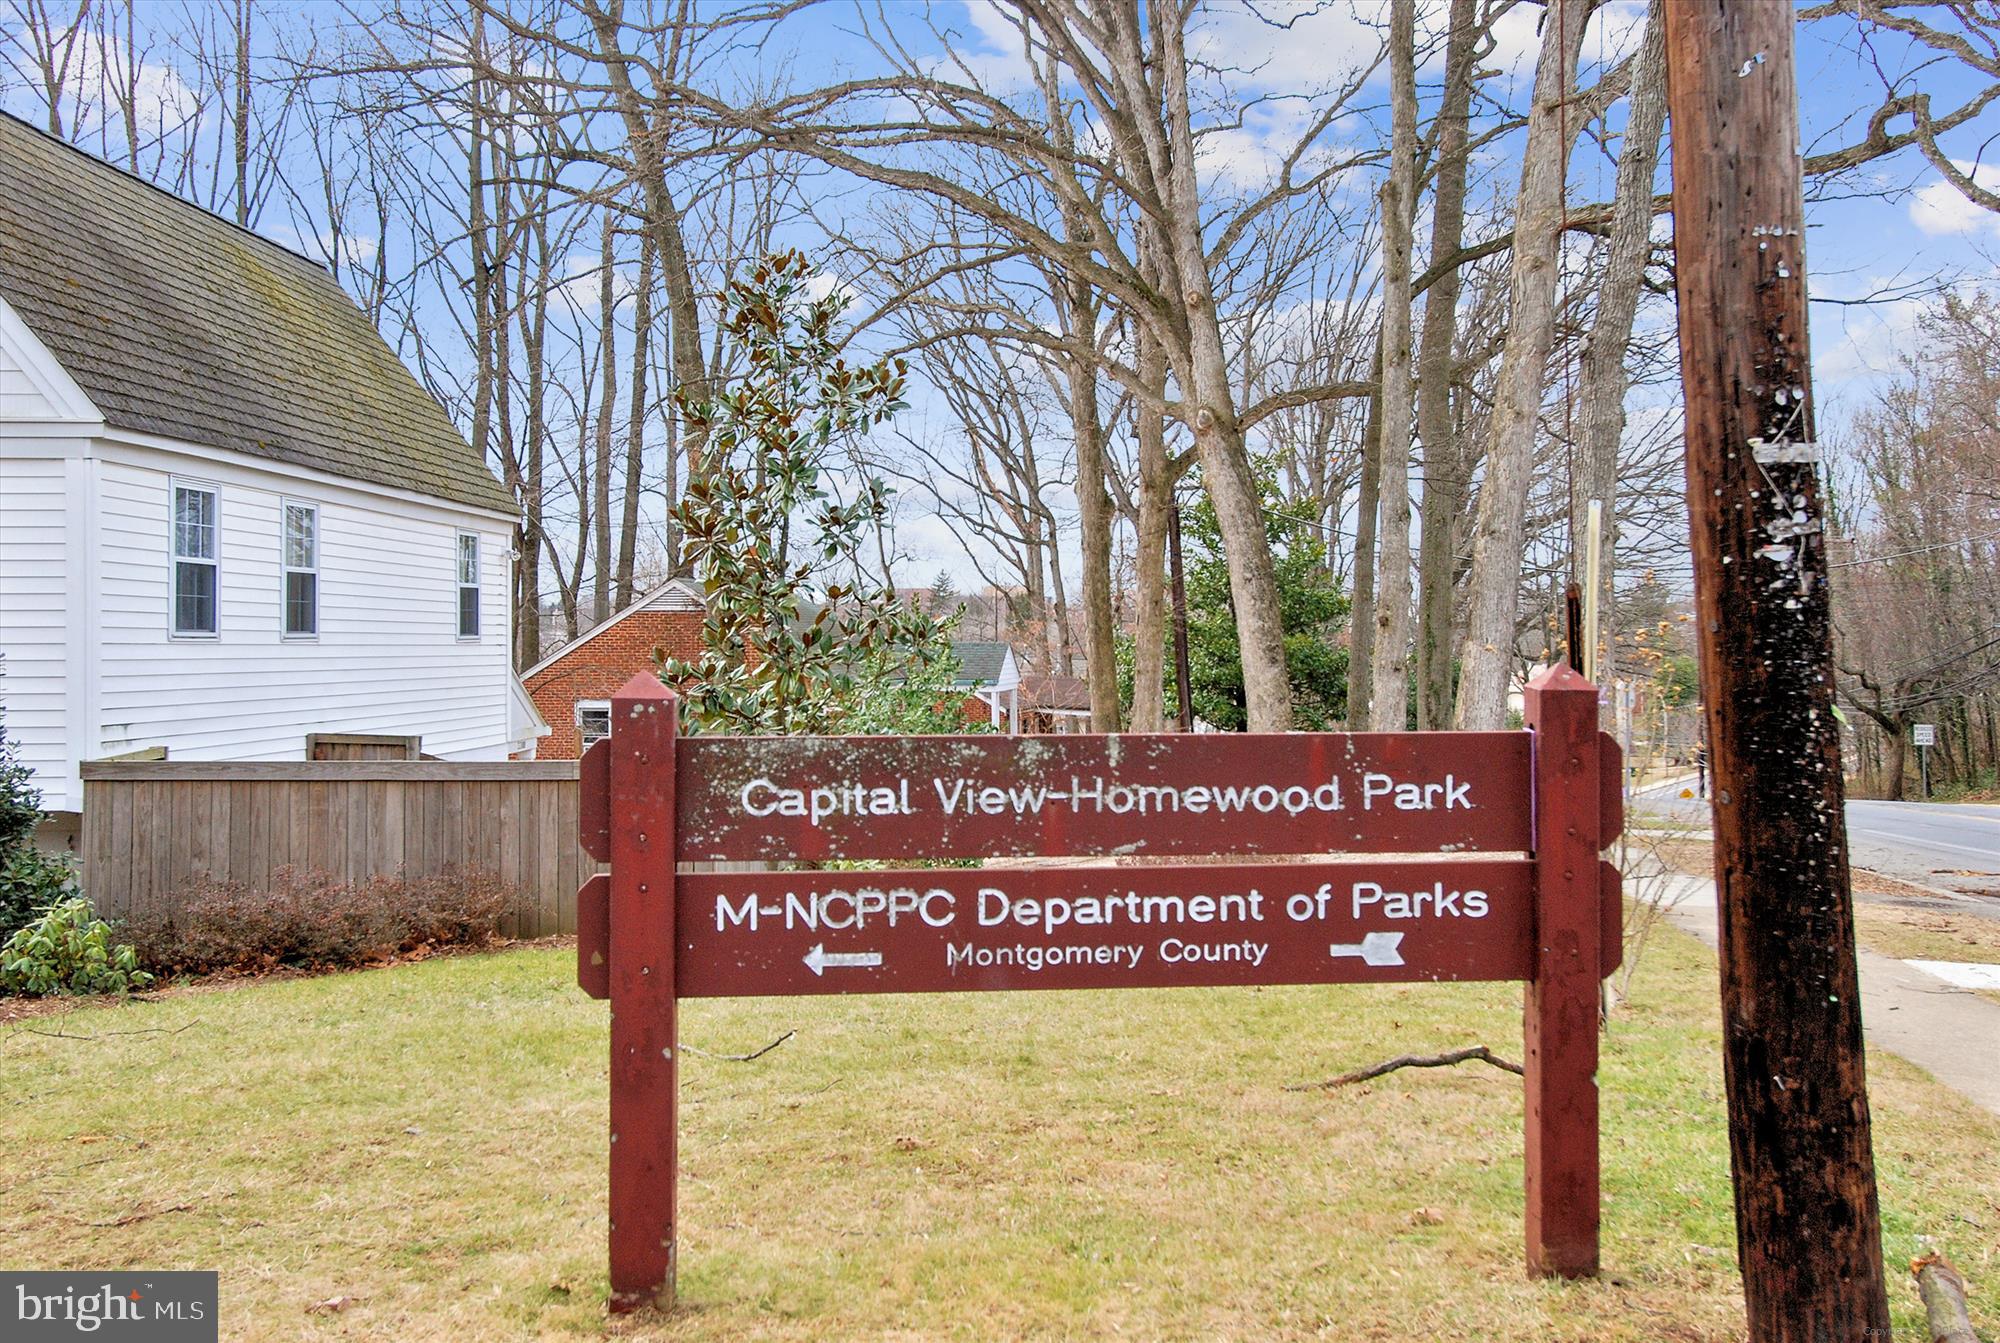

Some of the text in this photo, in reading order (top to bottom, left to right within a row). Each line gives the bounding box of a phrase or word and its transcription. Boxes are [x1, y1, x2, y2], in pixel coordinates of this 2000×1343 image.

[741, 773, 1472, 825] Capital View-Homewood Park
[715, 881, 1490, 935] M-NCPPC Department of Parks
[946, 938, 1268, 972] Montgomery County
